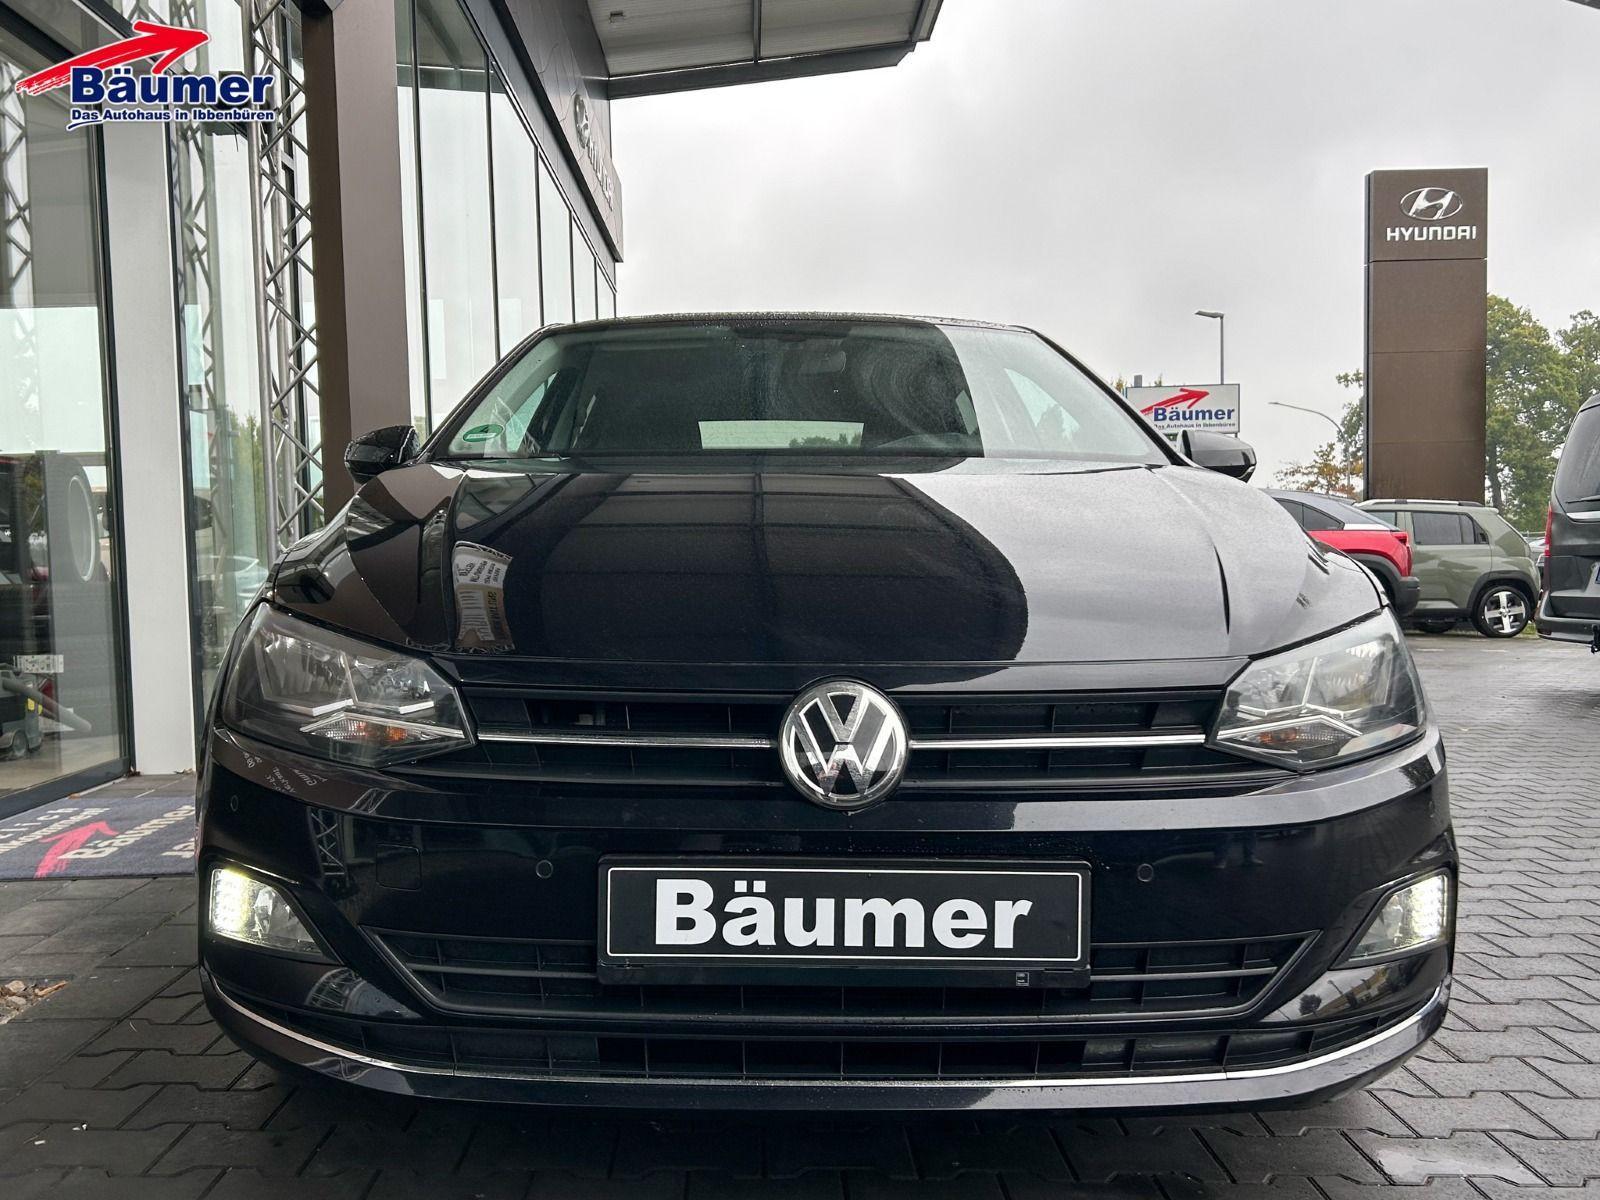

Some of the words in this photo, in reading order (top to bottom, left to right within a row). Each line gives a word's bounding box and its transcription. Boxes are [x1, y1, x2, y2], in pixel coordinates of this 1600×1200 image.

[1386, 226, 1477, 241] HYUNDAI
[1153, 407, 1236, 421] Bäumer
[655, 878, 1033, 950] Bäumer
